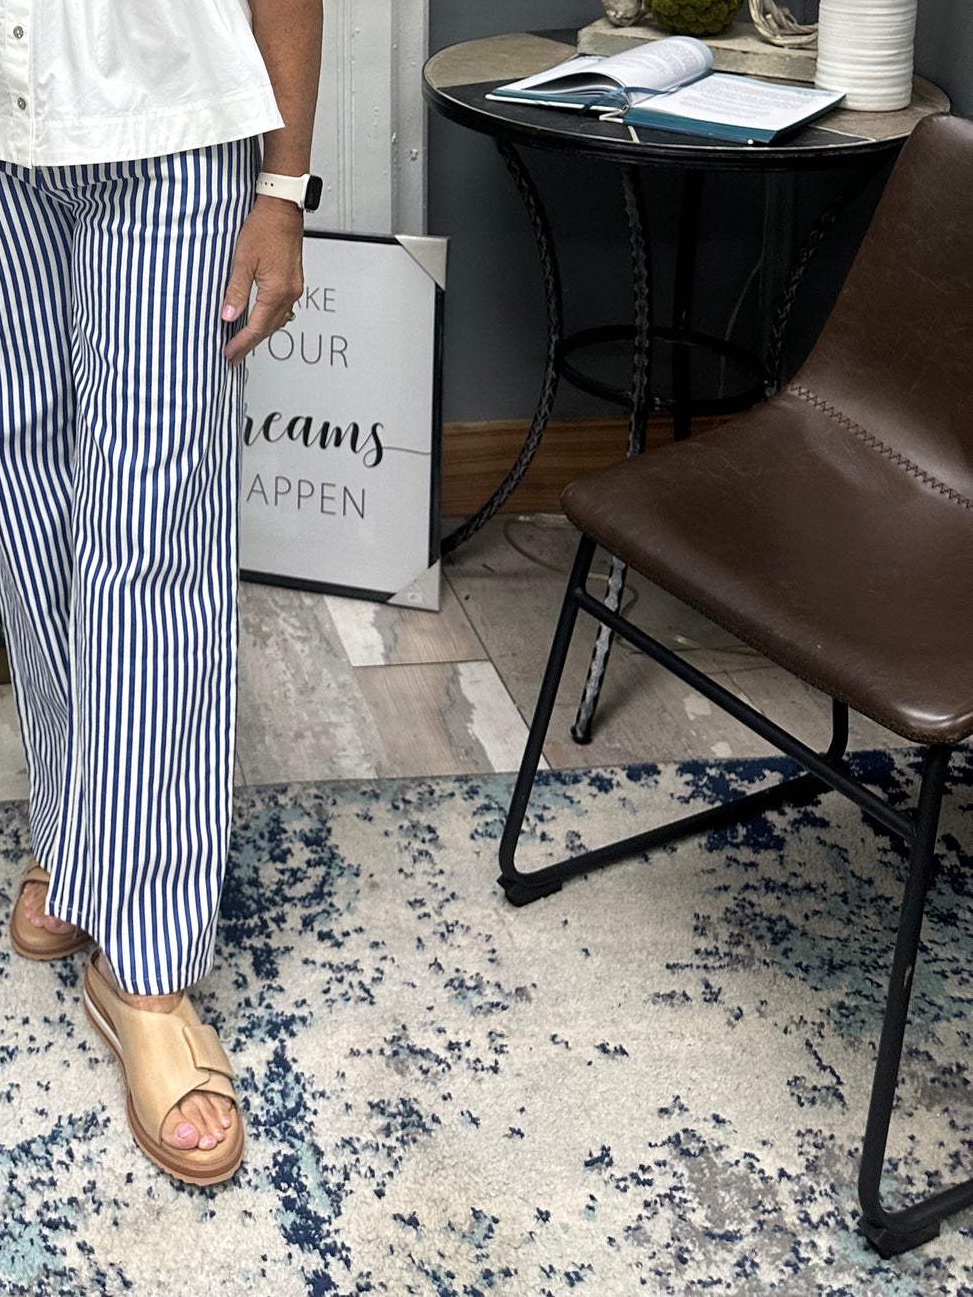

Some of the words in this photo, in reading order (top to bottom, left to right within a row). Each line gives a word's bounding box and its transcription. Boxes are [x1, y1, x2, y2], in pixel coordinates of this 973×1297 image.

[296, 287, 336, 313] KE
[252, 329, 348, 369] OUR
[244, 403, 430, 469] reams
[246, 473, 365, 519] APPEN
